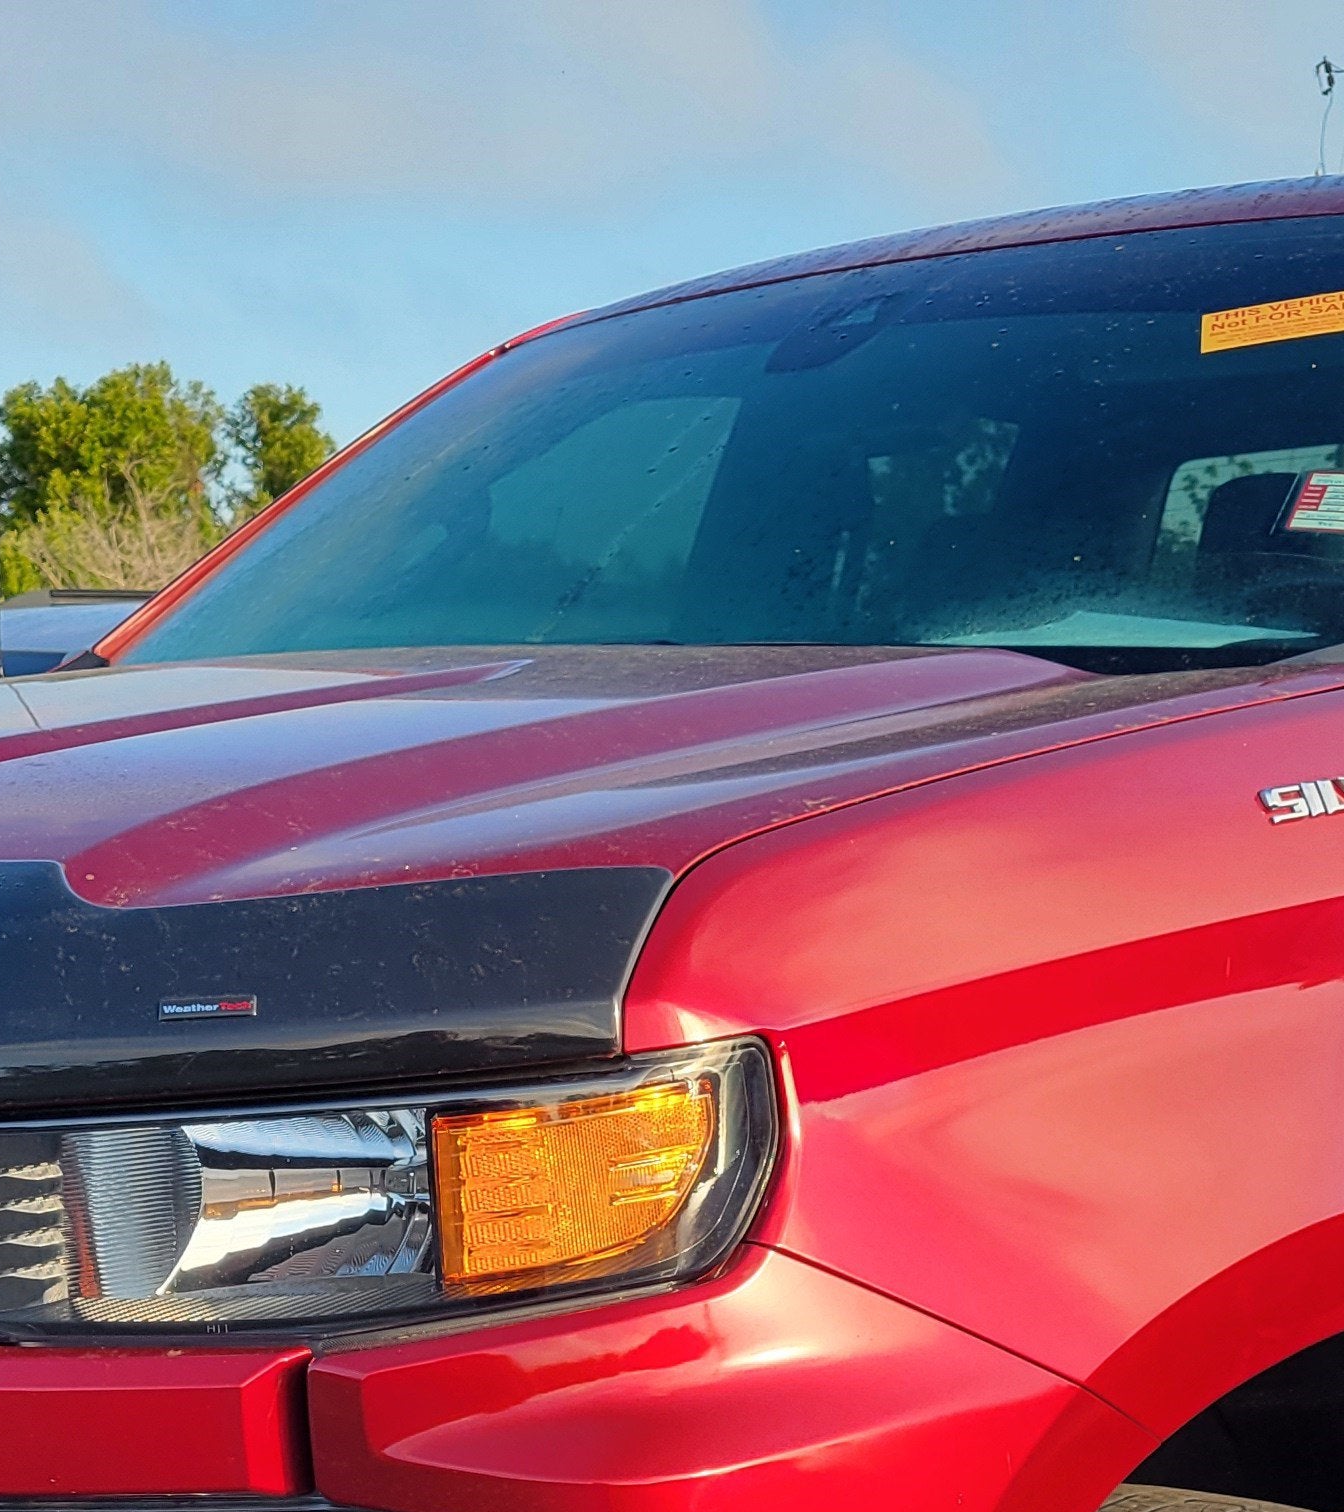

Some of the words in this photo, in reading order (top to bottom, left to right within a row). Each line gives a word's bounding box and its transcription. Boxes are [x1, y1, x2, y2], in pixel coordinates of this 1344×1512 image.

[1211, 318, 1247, 331] Not
[1255, 310, 1301, 323] FOR
[1212, 308, 1261, 322] THIS
